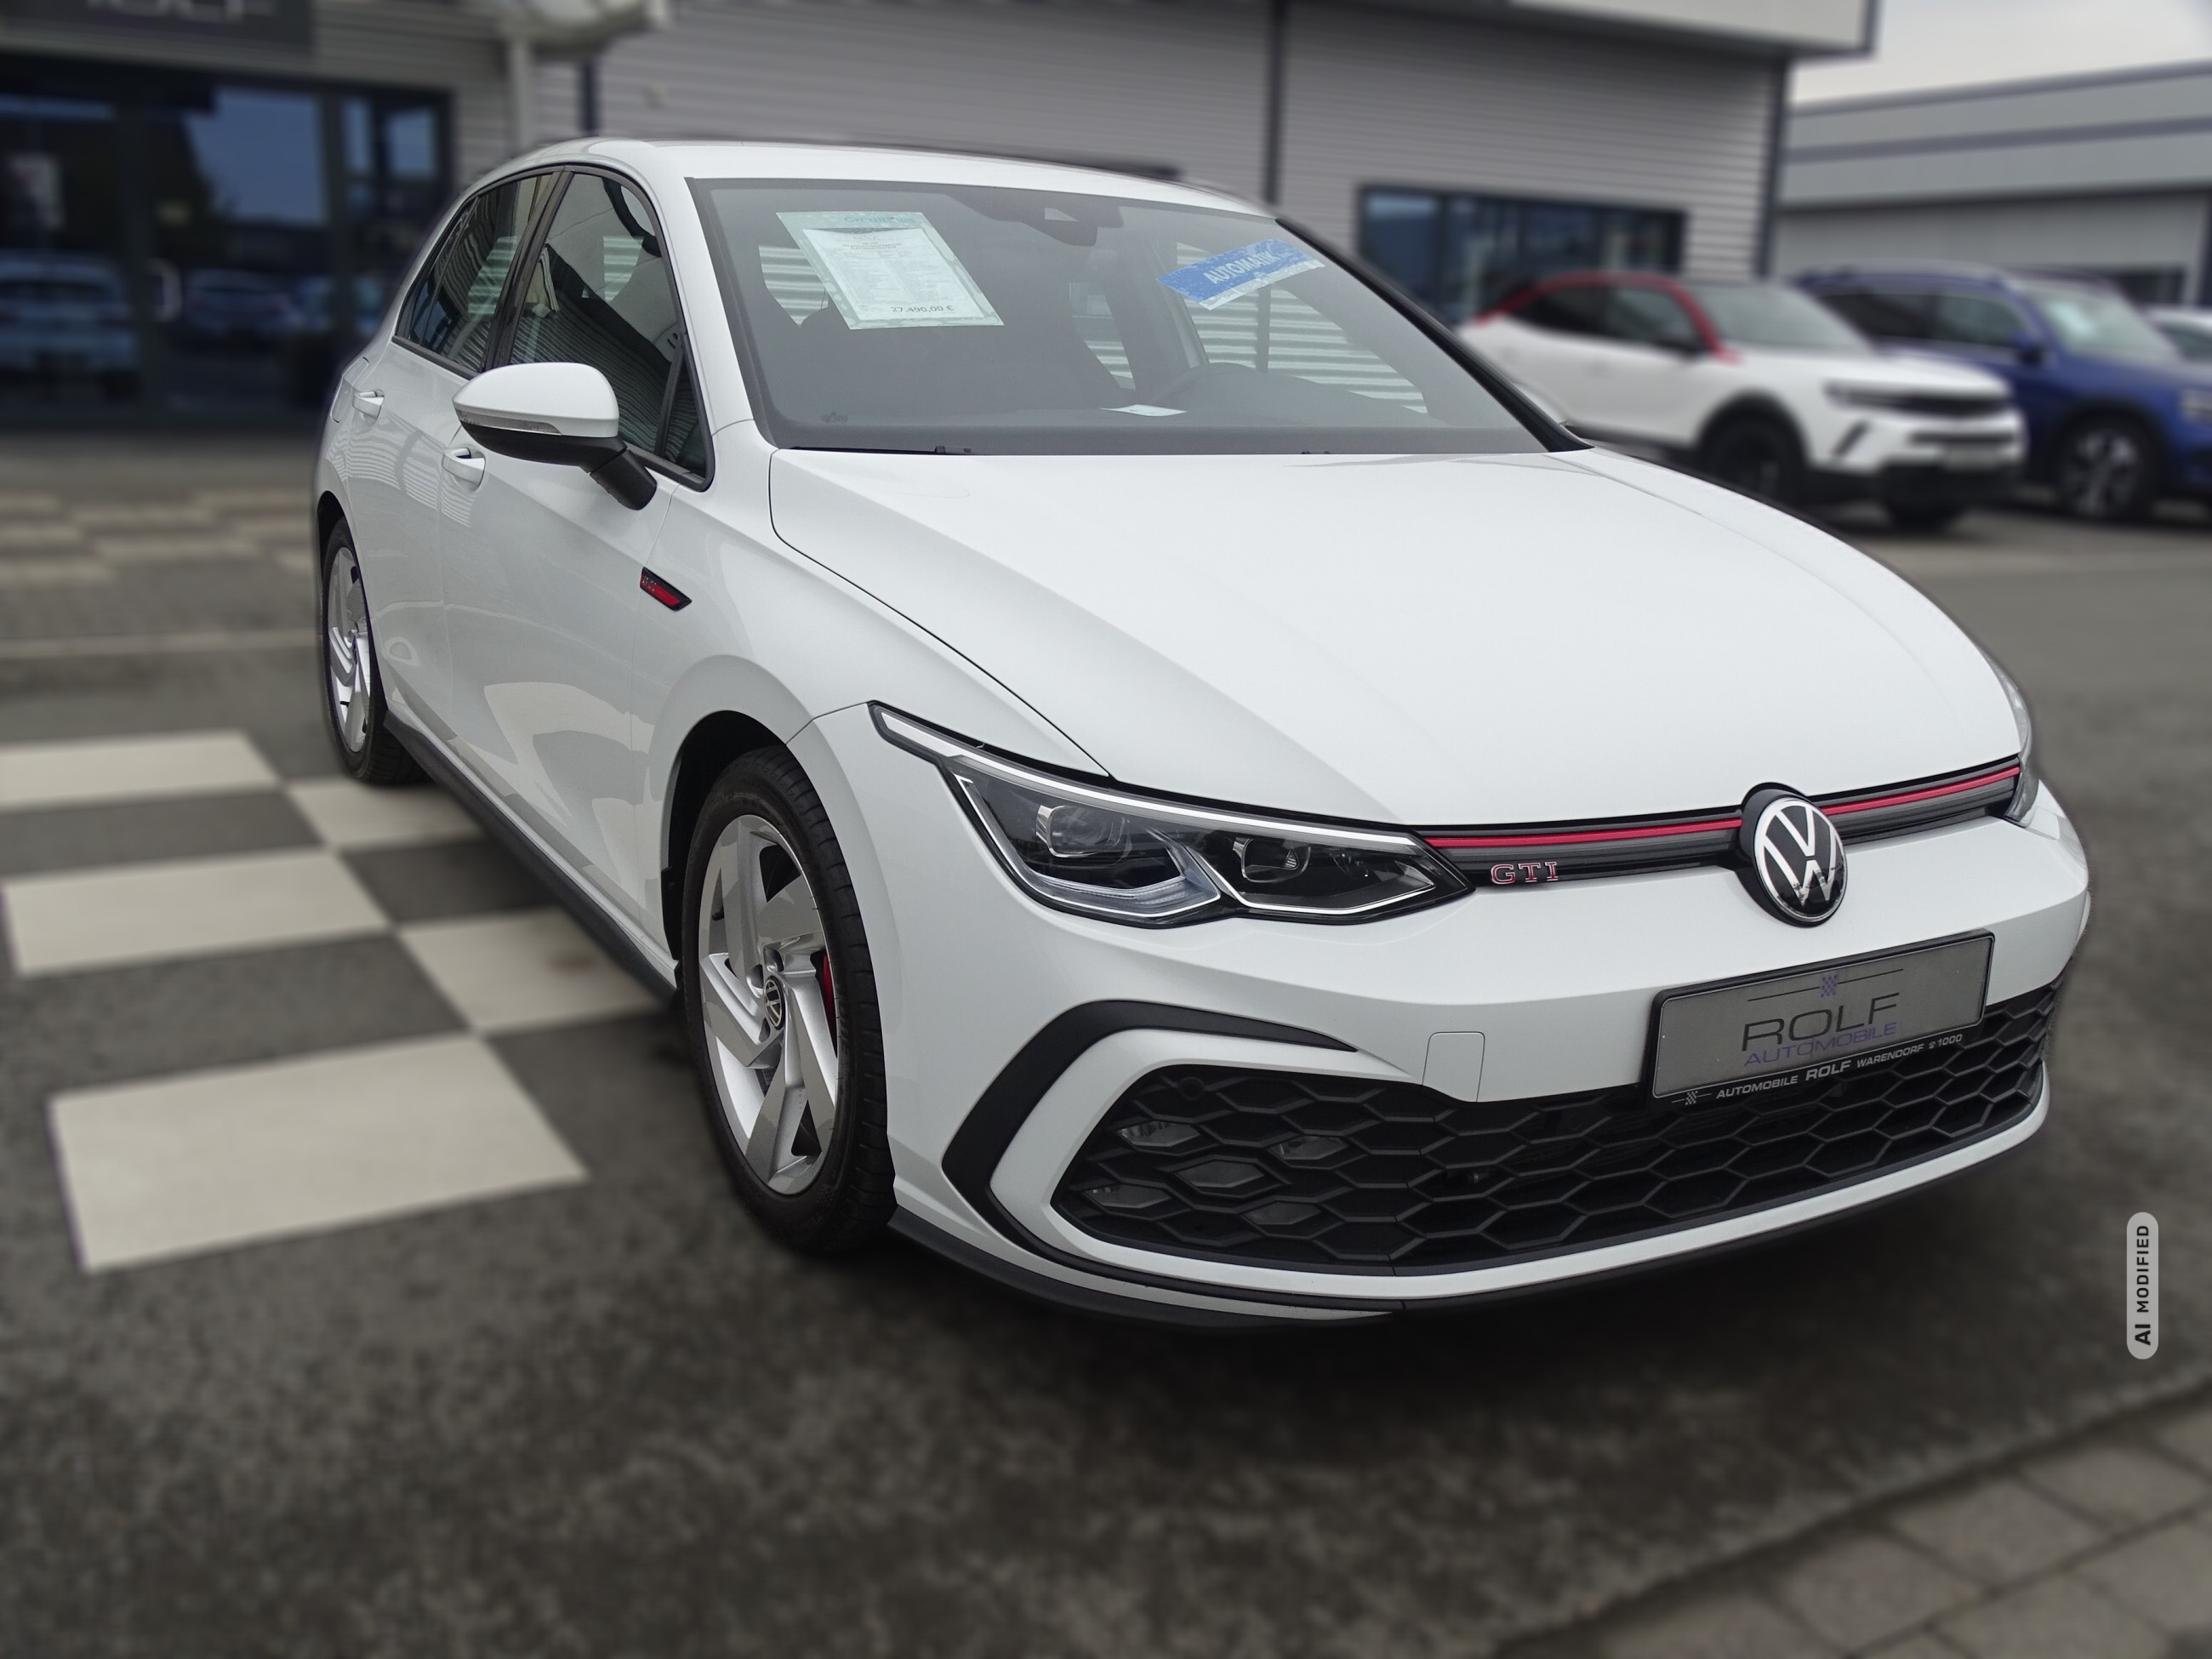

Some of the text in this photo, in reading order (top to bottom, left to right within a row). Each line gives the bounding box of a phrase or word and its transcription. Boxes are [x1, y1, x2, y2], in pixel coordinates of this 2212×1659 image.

[1202, 248, 1280, 284] AUTOMATIK
[1491, 861, 1559, 885] GTI
[1742, 992, 1900, 1052] ROLF
[1744, 1022, 1897, 1067] AUTOMOBILE
[1716, 1034, 1963, 1099] AUTOMOBILE ROLF WARENDORF 1000
